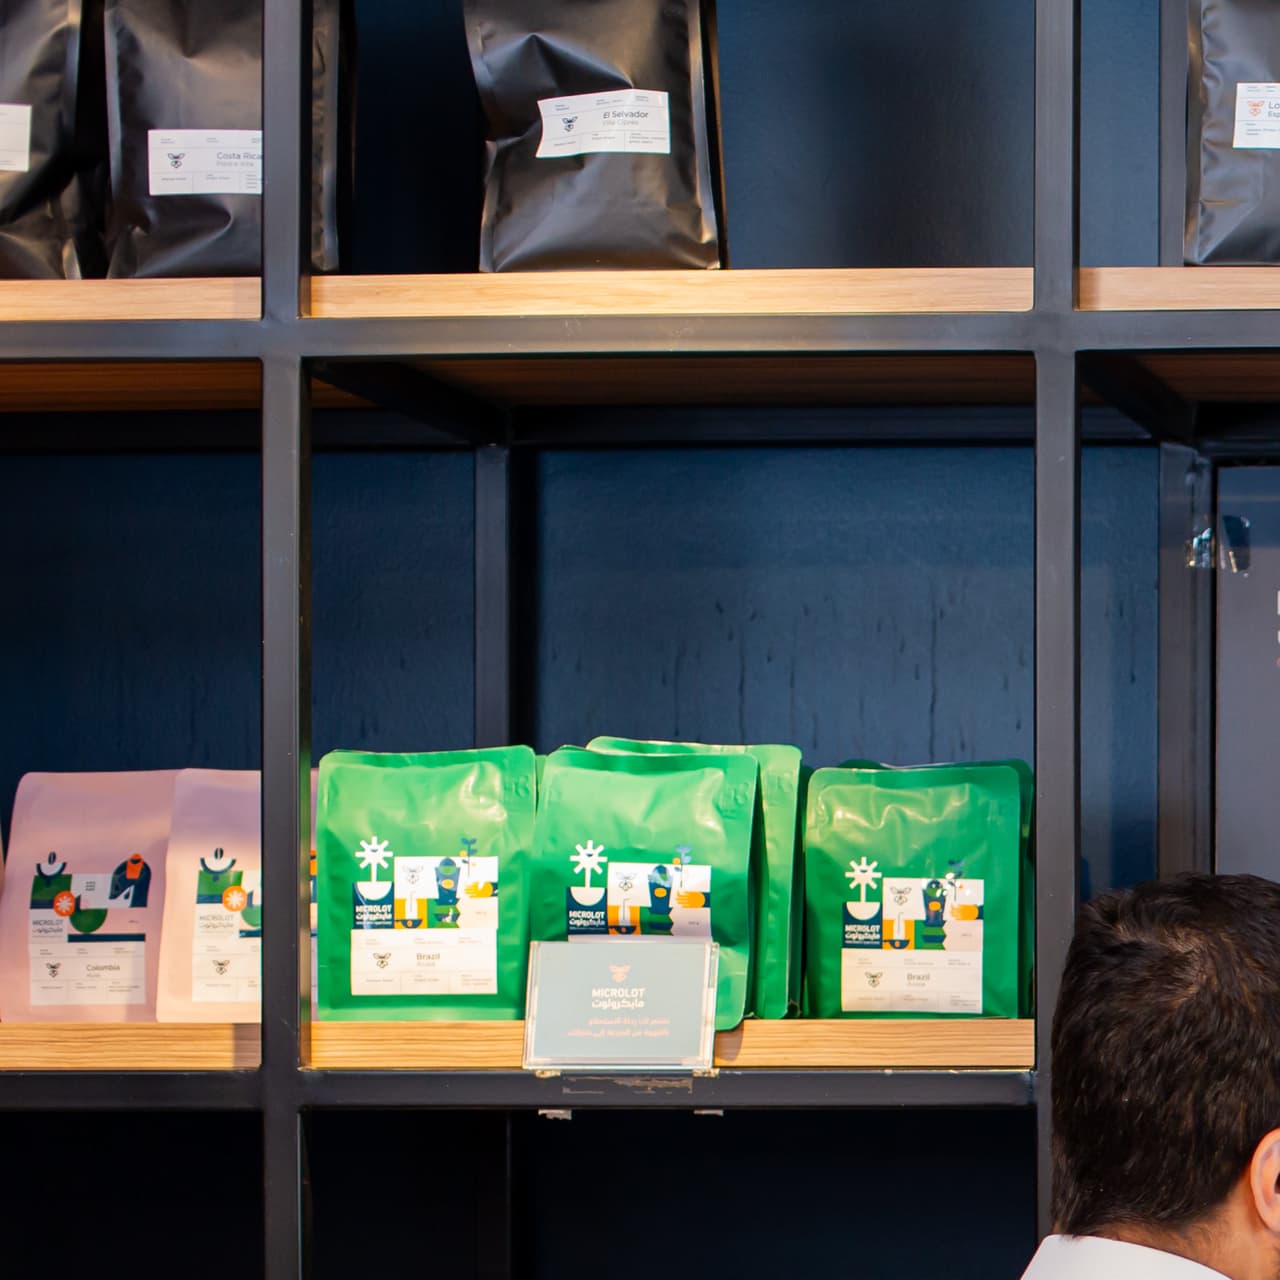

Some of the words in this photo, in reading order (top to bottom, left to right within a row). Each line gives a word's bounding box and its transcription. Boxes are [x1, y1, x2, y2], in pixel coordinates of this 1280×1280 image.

[216, 152, 241, 160] Costa
[355, 904, 392, 913] MICROLOT
[569, 910, 605, 919] MICROLOT
[416, 953, 441, 961] Brazil
[86, 963, 121, 972] Colombia
[906, 973, 931, 981] Brazil
[591, 988, 646, 998] MICROLOT
